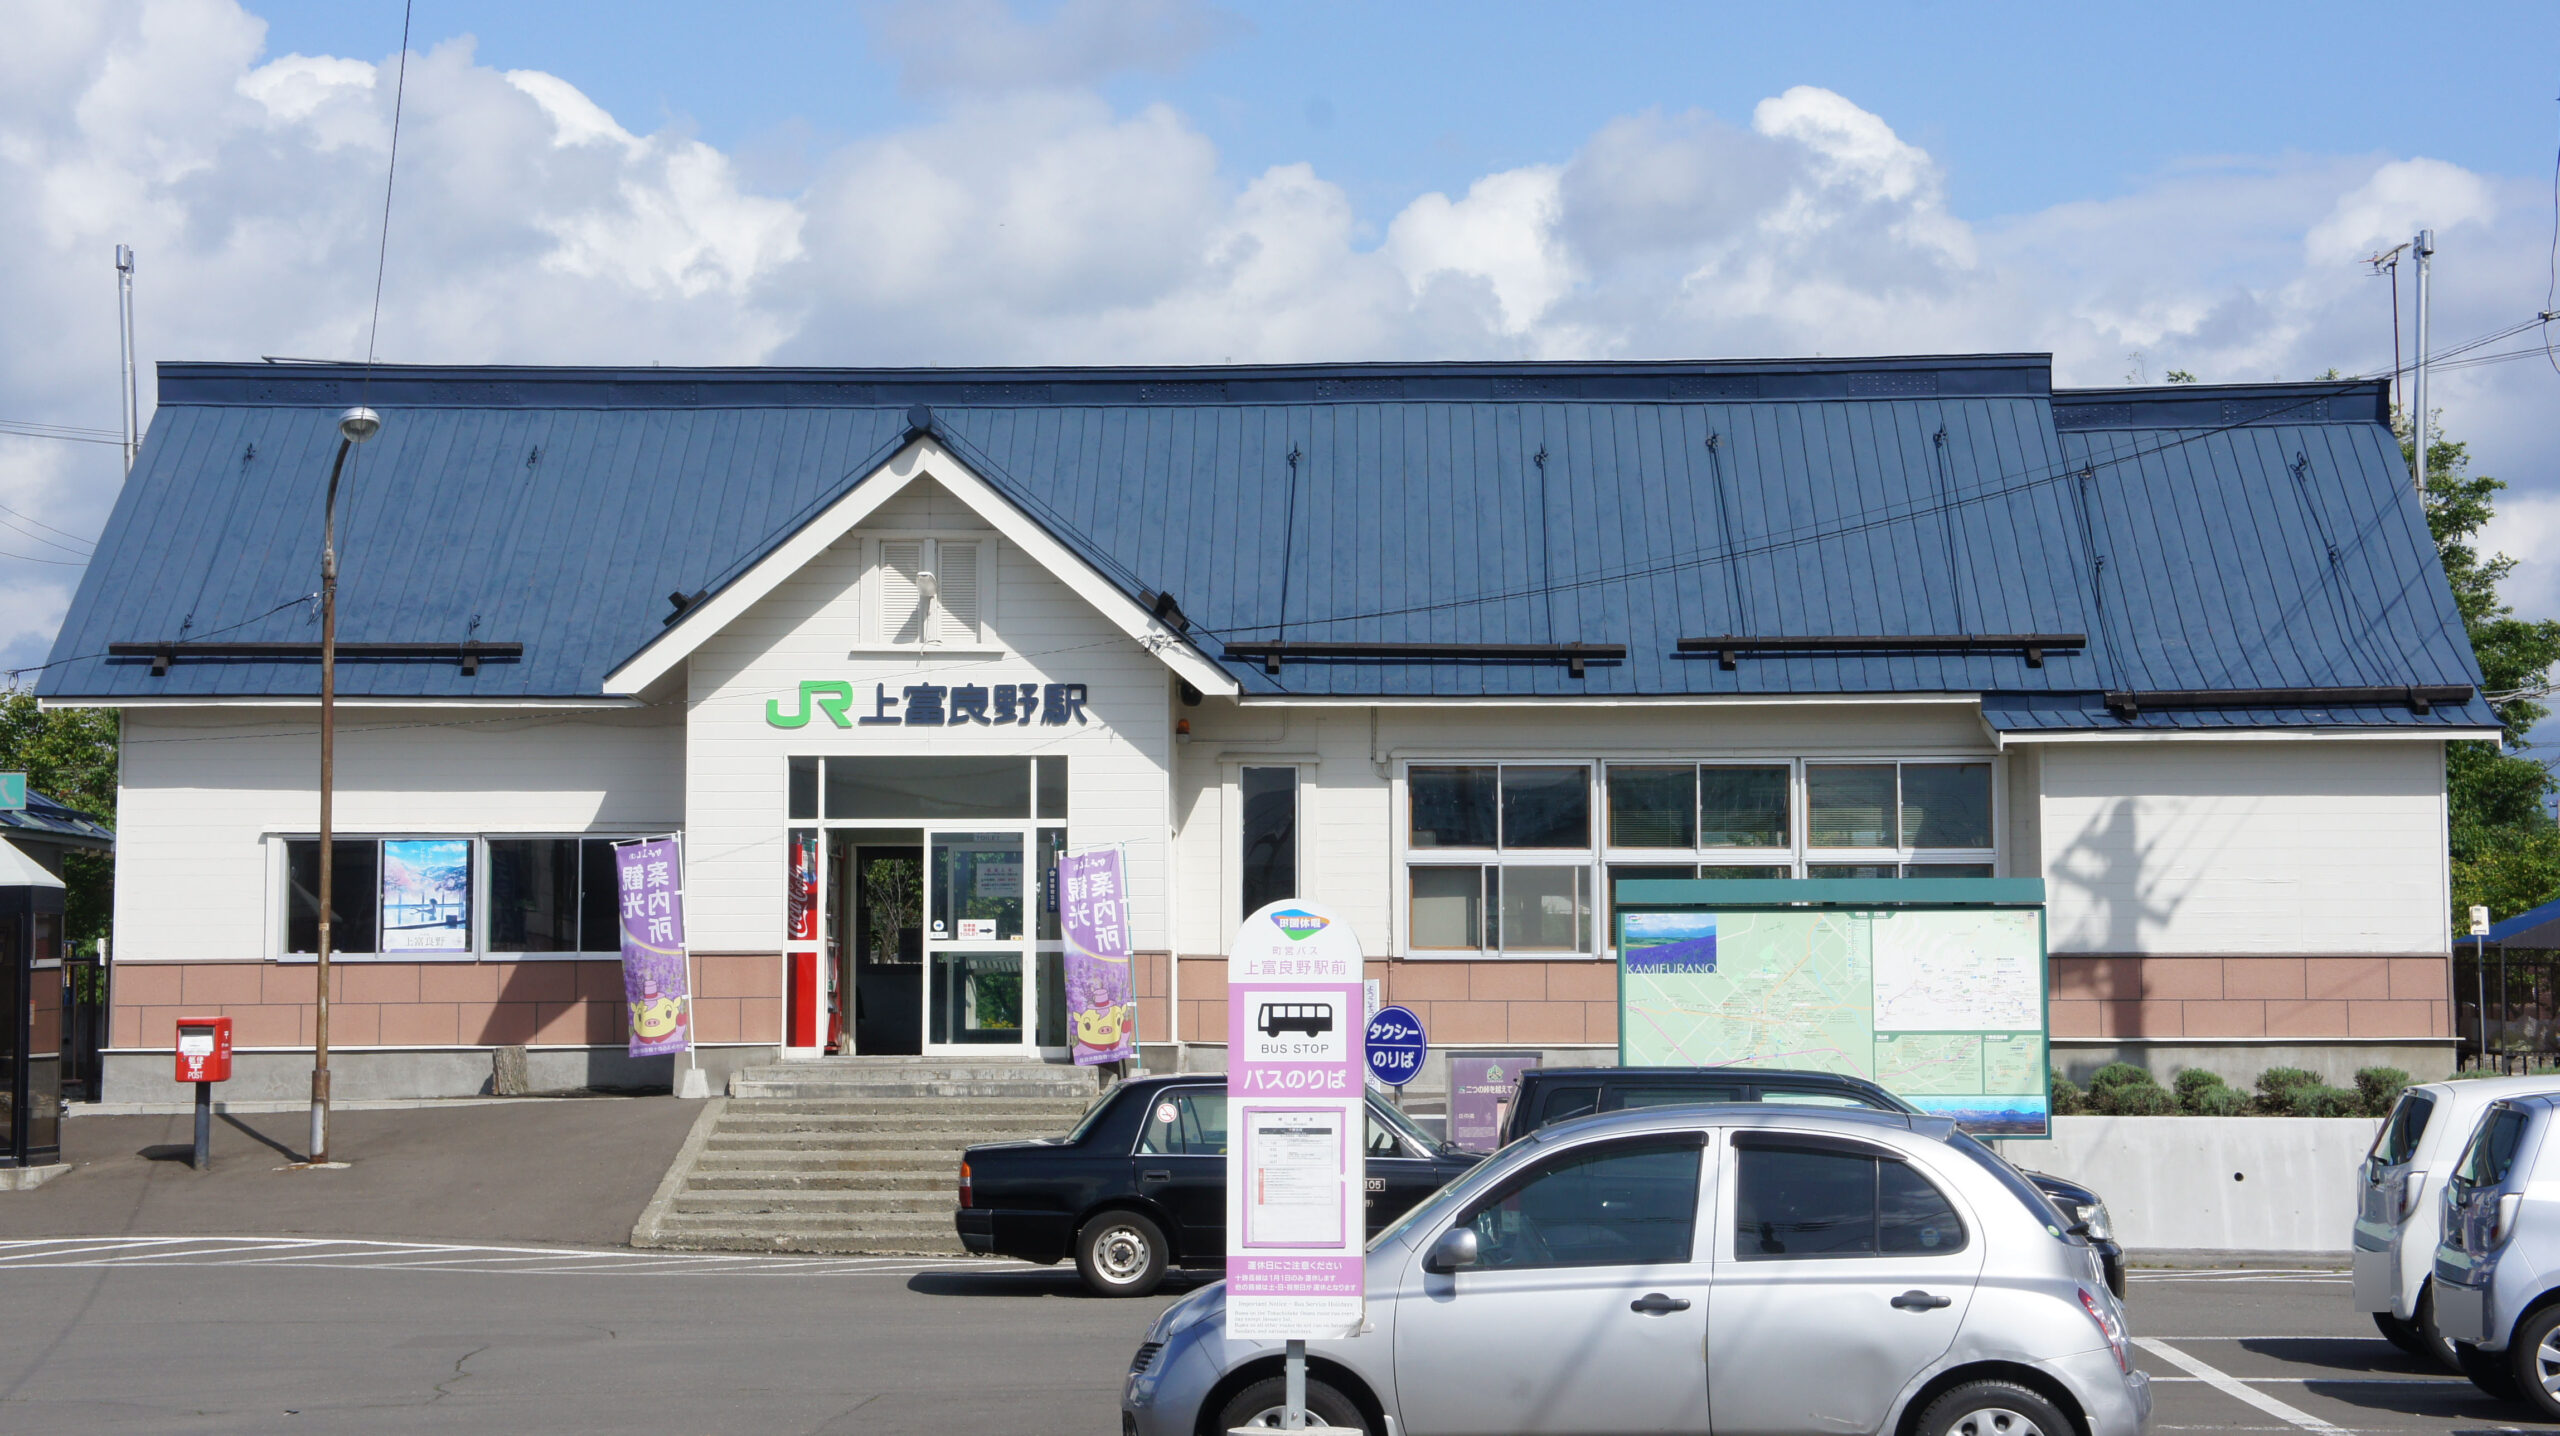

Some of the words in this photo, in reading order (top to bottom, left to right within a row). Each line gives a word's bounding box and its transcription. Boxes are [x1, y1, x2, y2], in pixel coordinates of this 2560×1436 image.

[766, 680, 853, 728] JR
[858, 682, 1088, 726] 上富良野駅
[1272, 945, 1319, 956] 町営バス
[1244, 959, 1347, 976] 上富良野駅前
[1626, 963, 1717, 974] KAMIFURANO
[1369, 1023, 1419, 1041] タクシー
[1261, 1044, 1288, 1054] BUS
[1293, 1044, 1329, 1054] STOP
[1372, 1051, 1415, 1068] のりば
[1244, 1069, 1347, 1090] バスのりば
